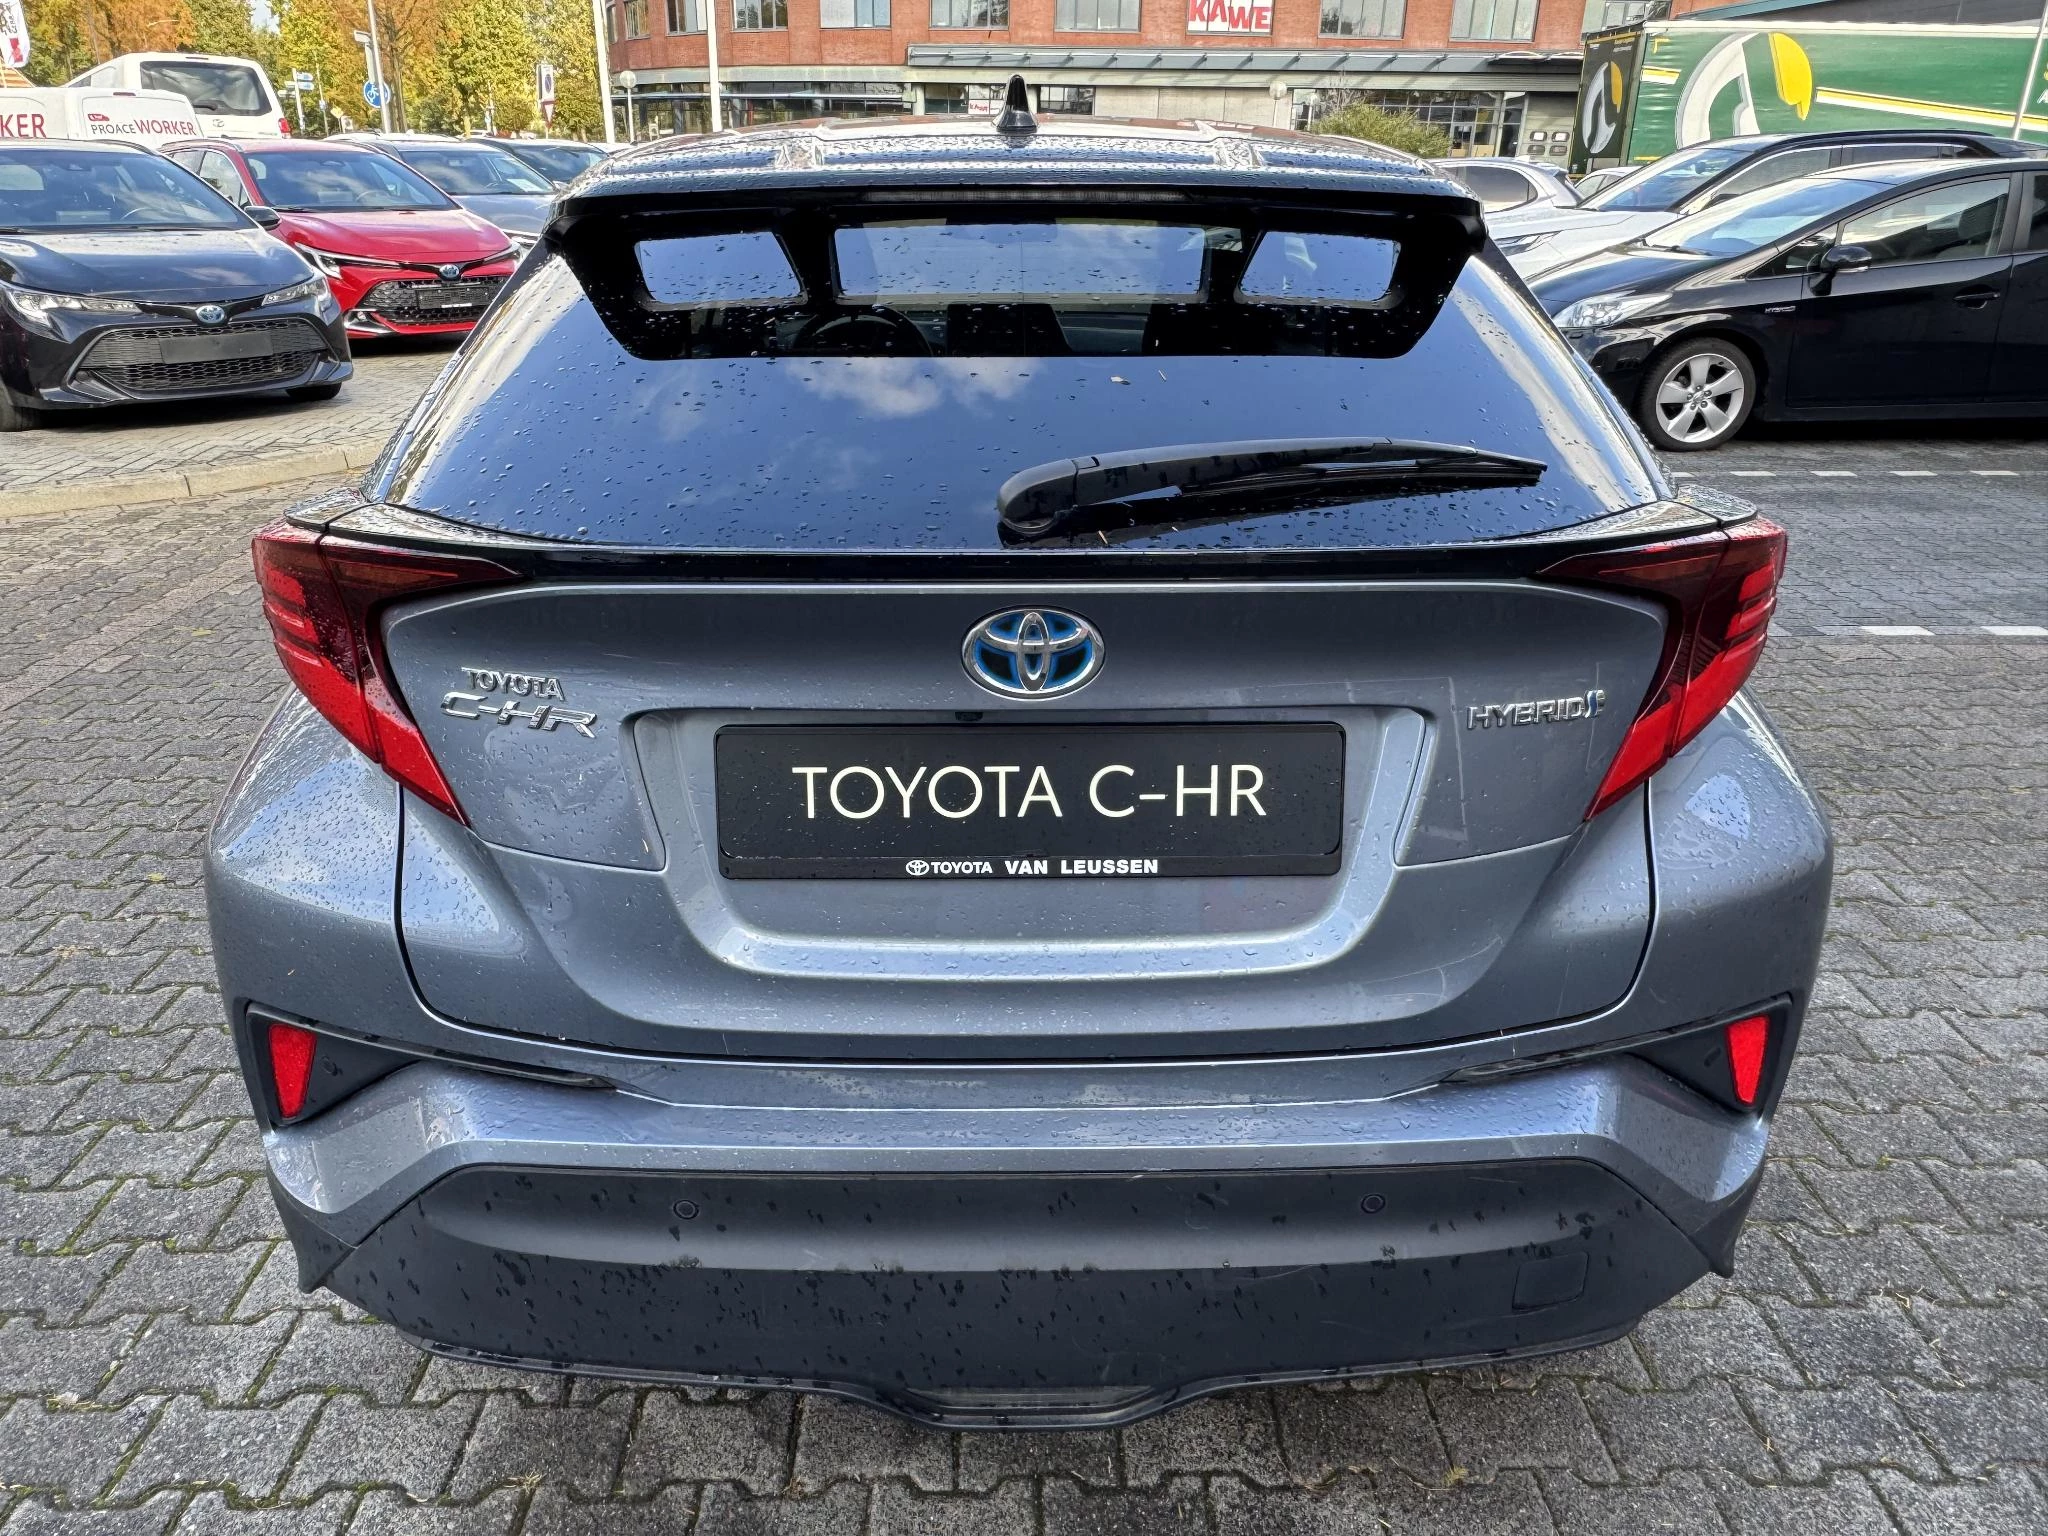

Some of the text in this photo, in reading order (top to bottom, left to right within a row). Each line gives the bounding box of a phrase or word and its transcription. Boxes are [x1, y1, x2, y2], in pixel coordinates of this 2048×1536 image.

[1189, 0, 1272, 29] KAWE
[460, 667, 565, 701] TOYOTA
[440, 692, 598, 739] C-HR
[1467, 697, 1585, 729] HYBRID
[791, 764, 1267, 820] TOYOTA C-HR
[930, 858, 1159, 875] TOYOTA VAN LEUSSEN
